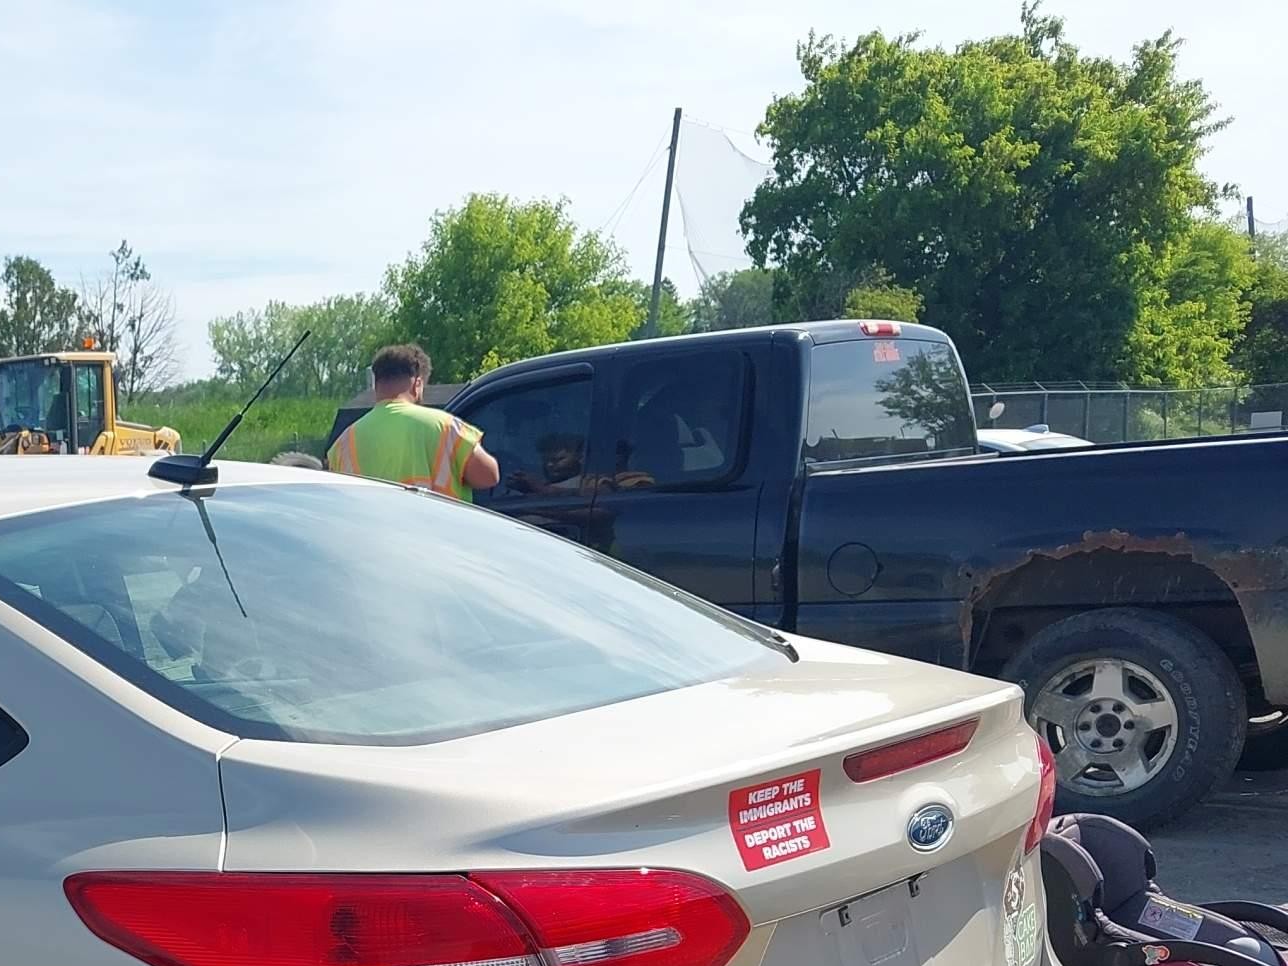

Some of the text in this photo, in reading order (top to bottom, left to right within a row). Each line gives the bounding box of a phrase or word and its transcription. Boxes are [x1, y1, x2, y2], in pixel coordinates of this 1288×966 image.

[748, 779, 805, 805] KEEP THE
[739, 793, 811, 824] IMMIGRANTS
[744, 816, 816, 848] DEPORT THE
[762, 836, 810, 860] RACISTS
